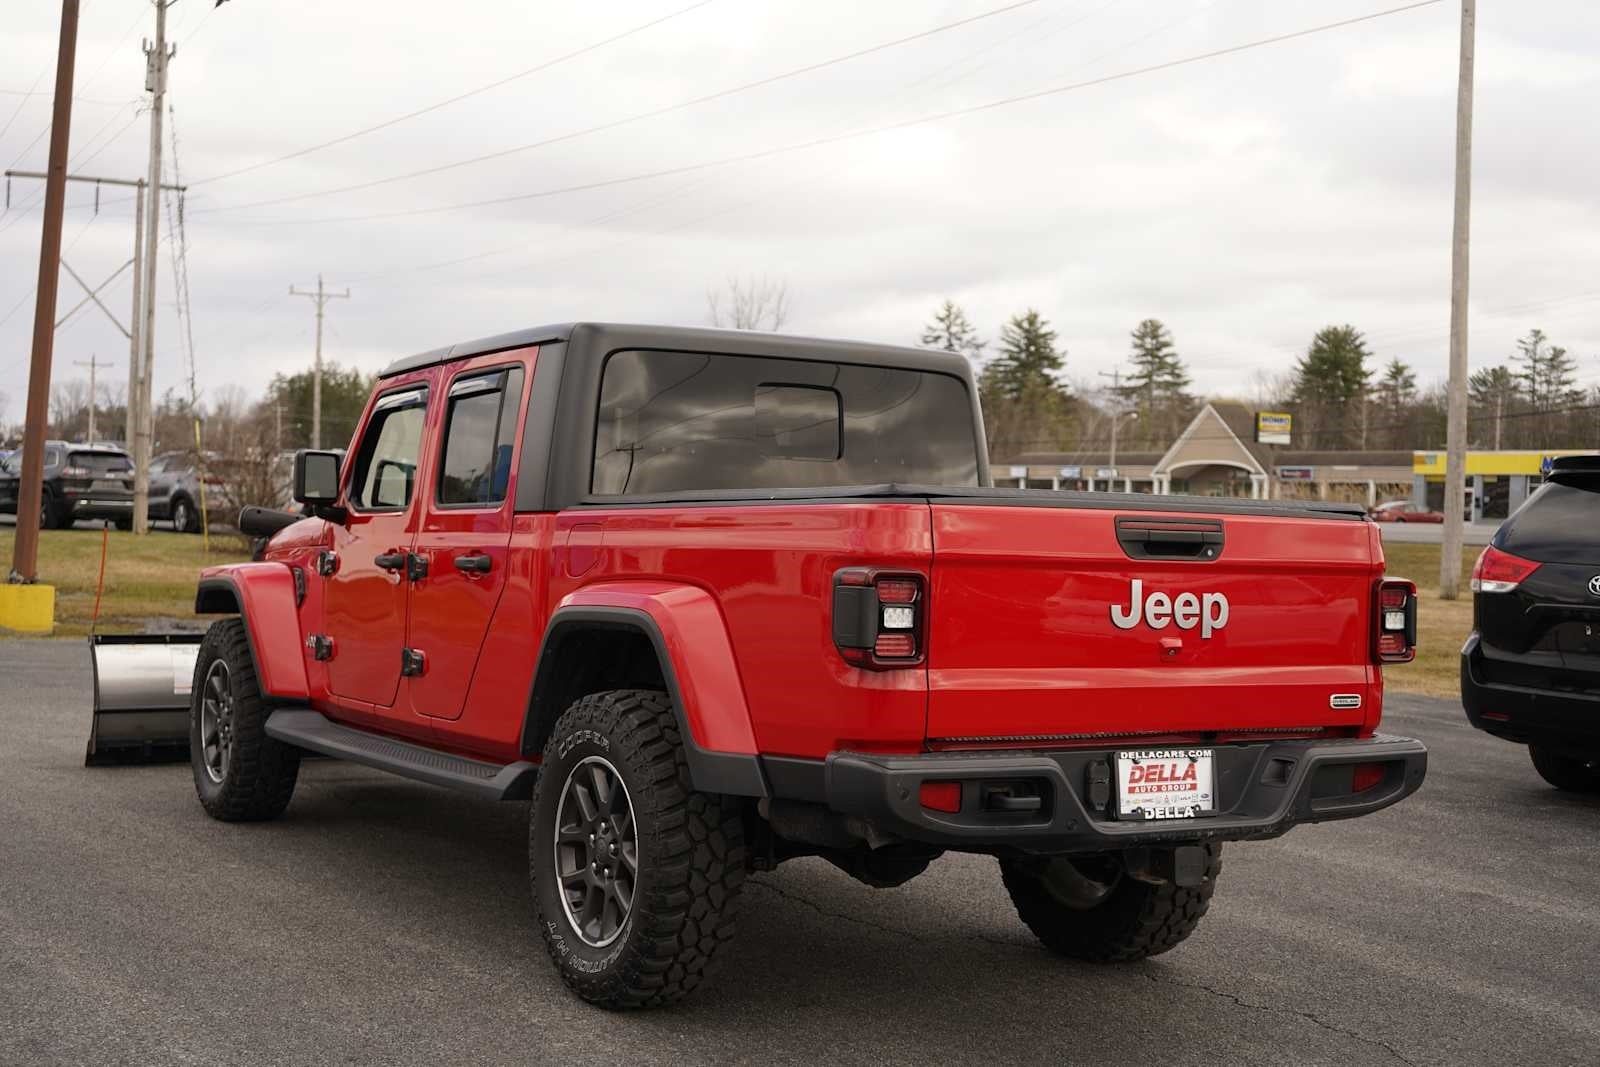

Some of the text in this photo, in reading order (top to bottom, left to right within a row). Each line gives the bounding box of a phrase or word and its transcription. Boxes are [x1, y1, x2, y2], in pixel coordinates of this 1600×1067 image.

[1110, 579, 1229, 639] Jeep
[558, 730, 610, 760] COOPER
[1120, 749, 1212, 759] DELLACARS.COM
[1128, 762, 1197, 784] DELLA
[1134, 783, 1191, 793] AUTO GROUP
[1144, 805, 1195, 819] DELLA
